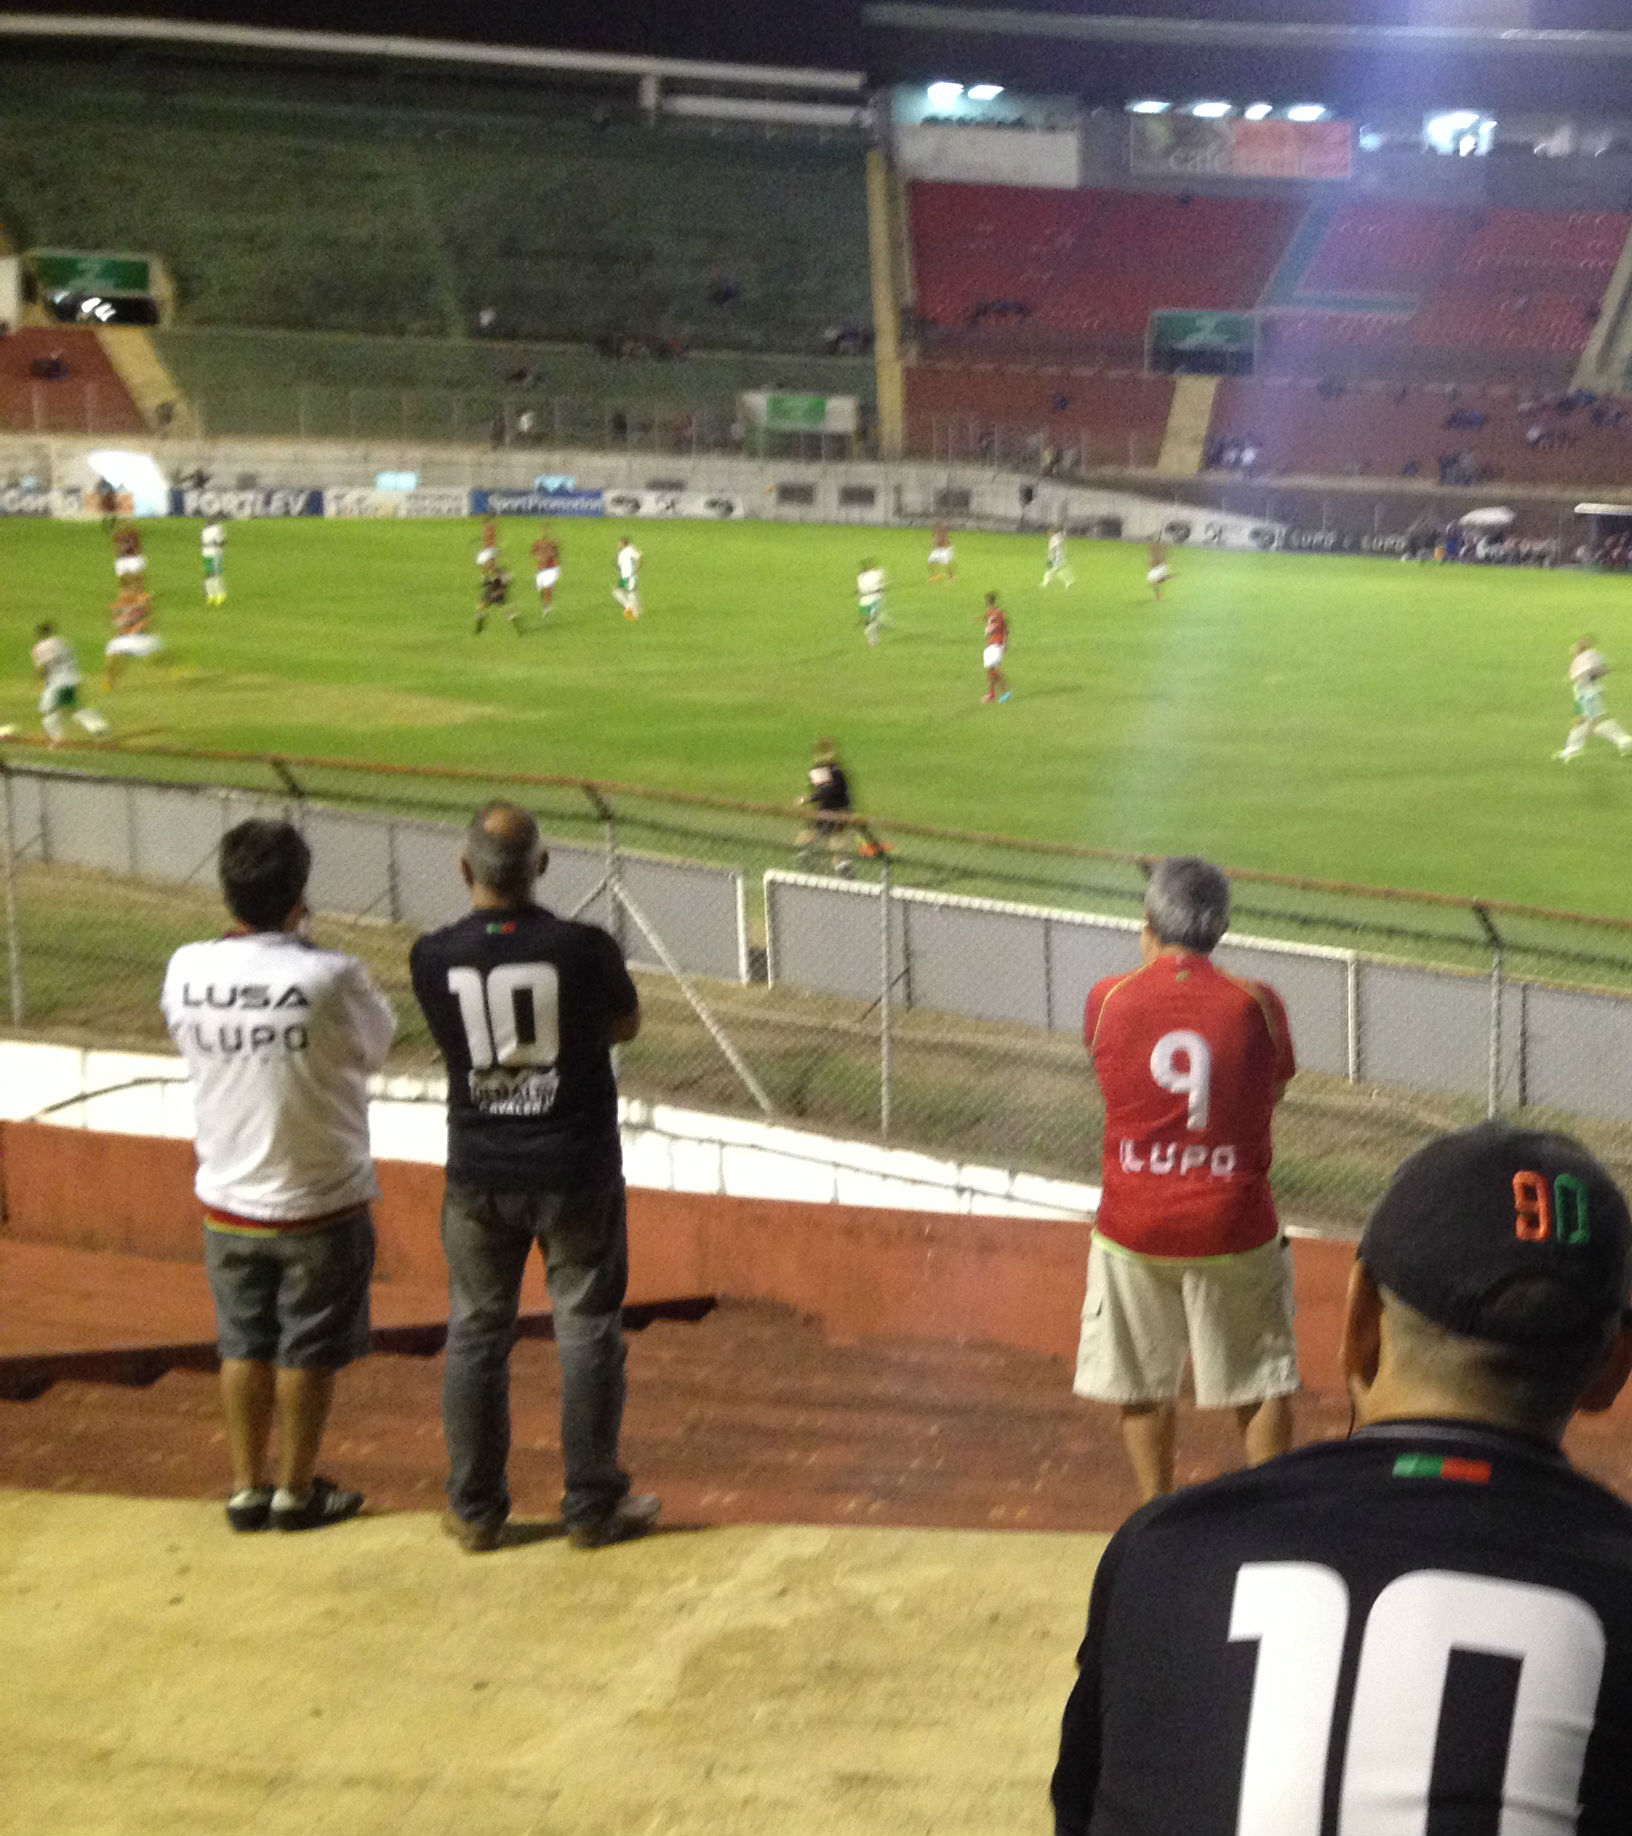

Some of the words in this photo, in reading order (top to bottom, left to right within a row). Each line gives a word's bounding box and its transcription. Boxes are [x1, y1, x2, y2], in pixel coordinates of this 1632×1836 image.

[182, 982, 310, 1010] LUSA
[448, 960, 560, 1071] 10
[189, 1021, 309, 1053] LUPO
[1150, 1029, 1212, 1131] 9
[1119, 1138, 1237, 1177] LUPO
[1512, 1169, 1589, 1244] 90
[1226, 1560, 1606, 1836] 10
